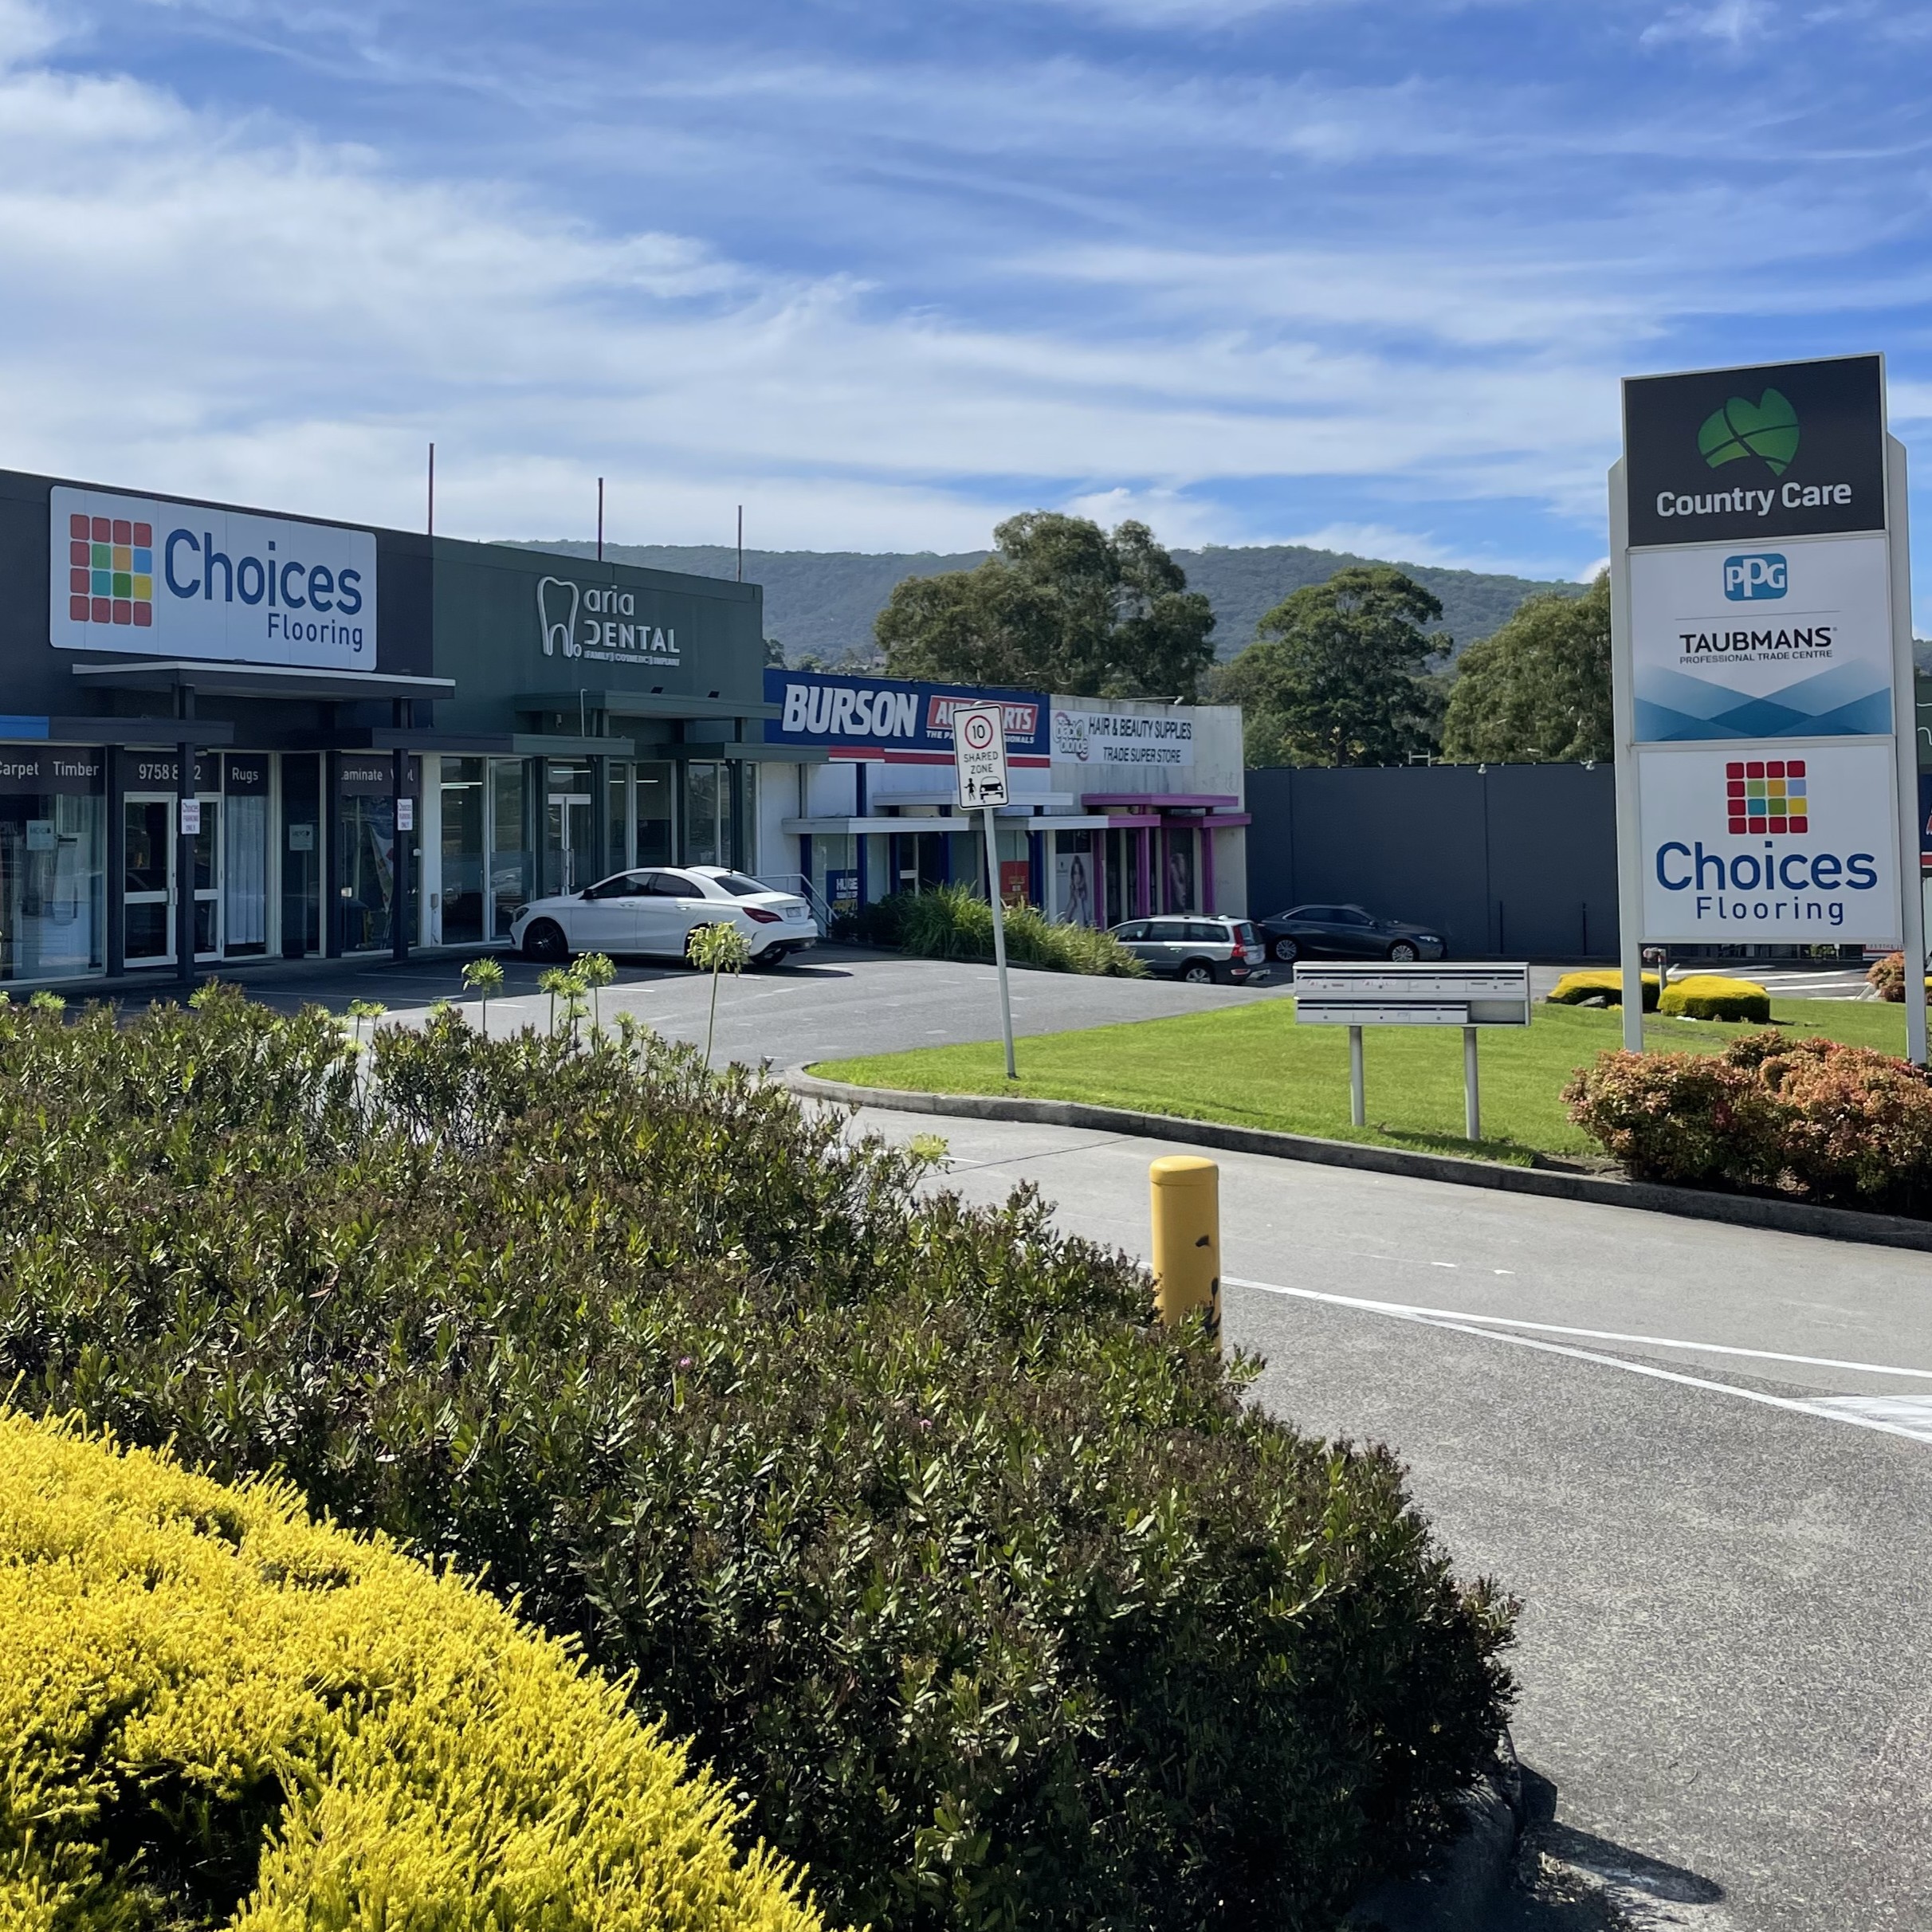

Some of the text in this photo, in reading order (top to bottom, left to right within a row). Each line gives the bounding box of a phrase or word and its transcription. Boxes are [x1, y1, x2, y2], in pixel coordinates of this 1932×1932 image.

[1656, 481, 1852, 516] Country Care
[165, 529, 362, 615] Choices
[1726, 558, 1785, 597] PPG
[583, 585, 634, 616] aria
[268, 613, 363, 652] Flooring
[583, 619, 680, 653] DENTAL
[1679, 626, 1832, 654] TAUBMANS
[1679, 650, 1832, 664] PROFESSIONAL TRADE CENTRE
[782, 683, 918, 738] BURSON
[926, 730, 943, 739] THE
[972, 724, 985, 739] 10
[1089, 717, 1192, 740] HAIR & BEAUTY SUPPLIES
[964, 752, 998, 762] SHARED
[1103, 746, 1181, 763] TRADE SUPER STORE
[53, 761, 99, 776] Timber
[139, 764, 201, 780] 9758 82
[232, 767, 259, 783] Rugs
[341, 768, 383, 781] aminate
[970, 764, 993, 774] ZONE
[1656, 841, 1878, 890] Choices
[1696, 897, 1844, 925] Flooring
